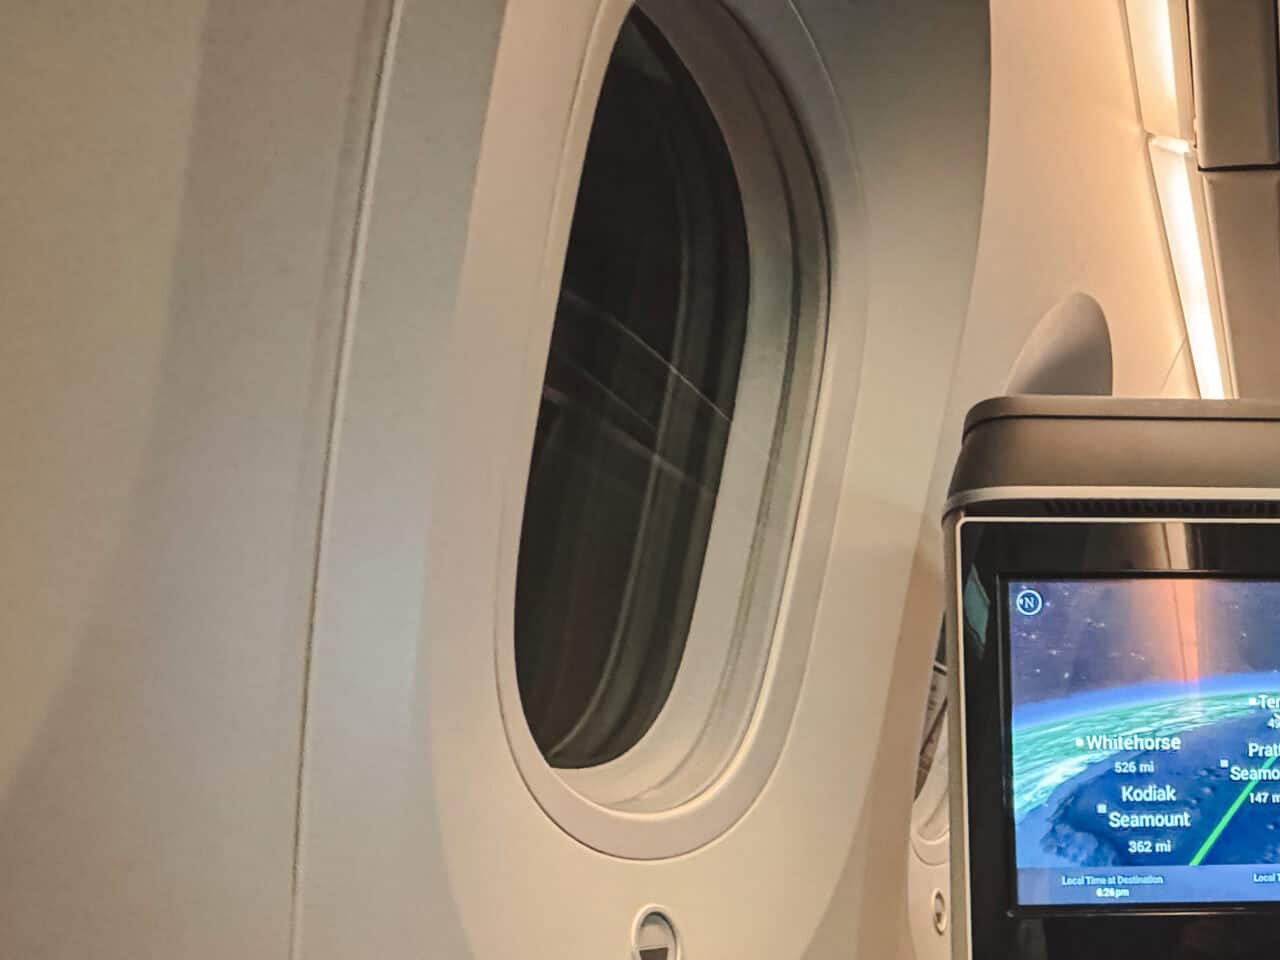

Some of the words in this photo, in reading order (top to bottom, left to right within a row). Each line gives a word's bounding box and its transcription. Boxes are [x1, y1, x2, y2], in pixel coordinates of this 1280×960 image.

[1086, 735, 1182, 750] Whitehorse
[1114, 761, 1137, 773] 526
[1139, 760, 1155, 773] mi
[1121, 784, 1177, 802] Kodiak
[1250, 792, 1269, 804] 147
[1108, 811, 1191, 828] Seamount
[1128, 840, 1152, 853] 362
[1155, 839, 1172, 853] mi
[1062, 875, 1085, 886] Local
[1085, 875, 1107, 885] Time
[1253, 872, 1276, 882] Local
